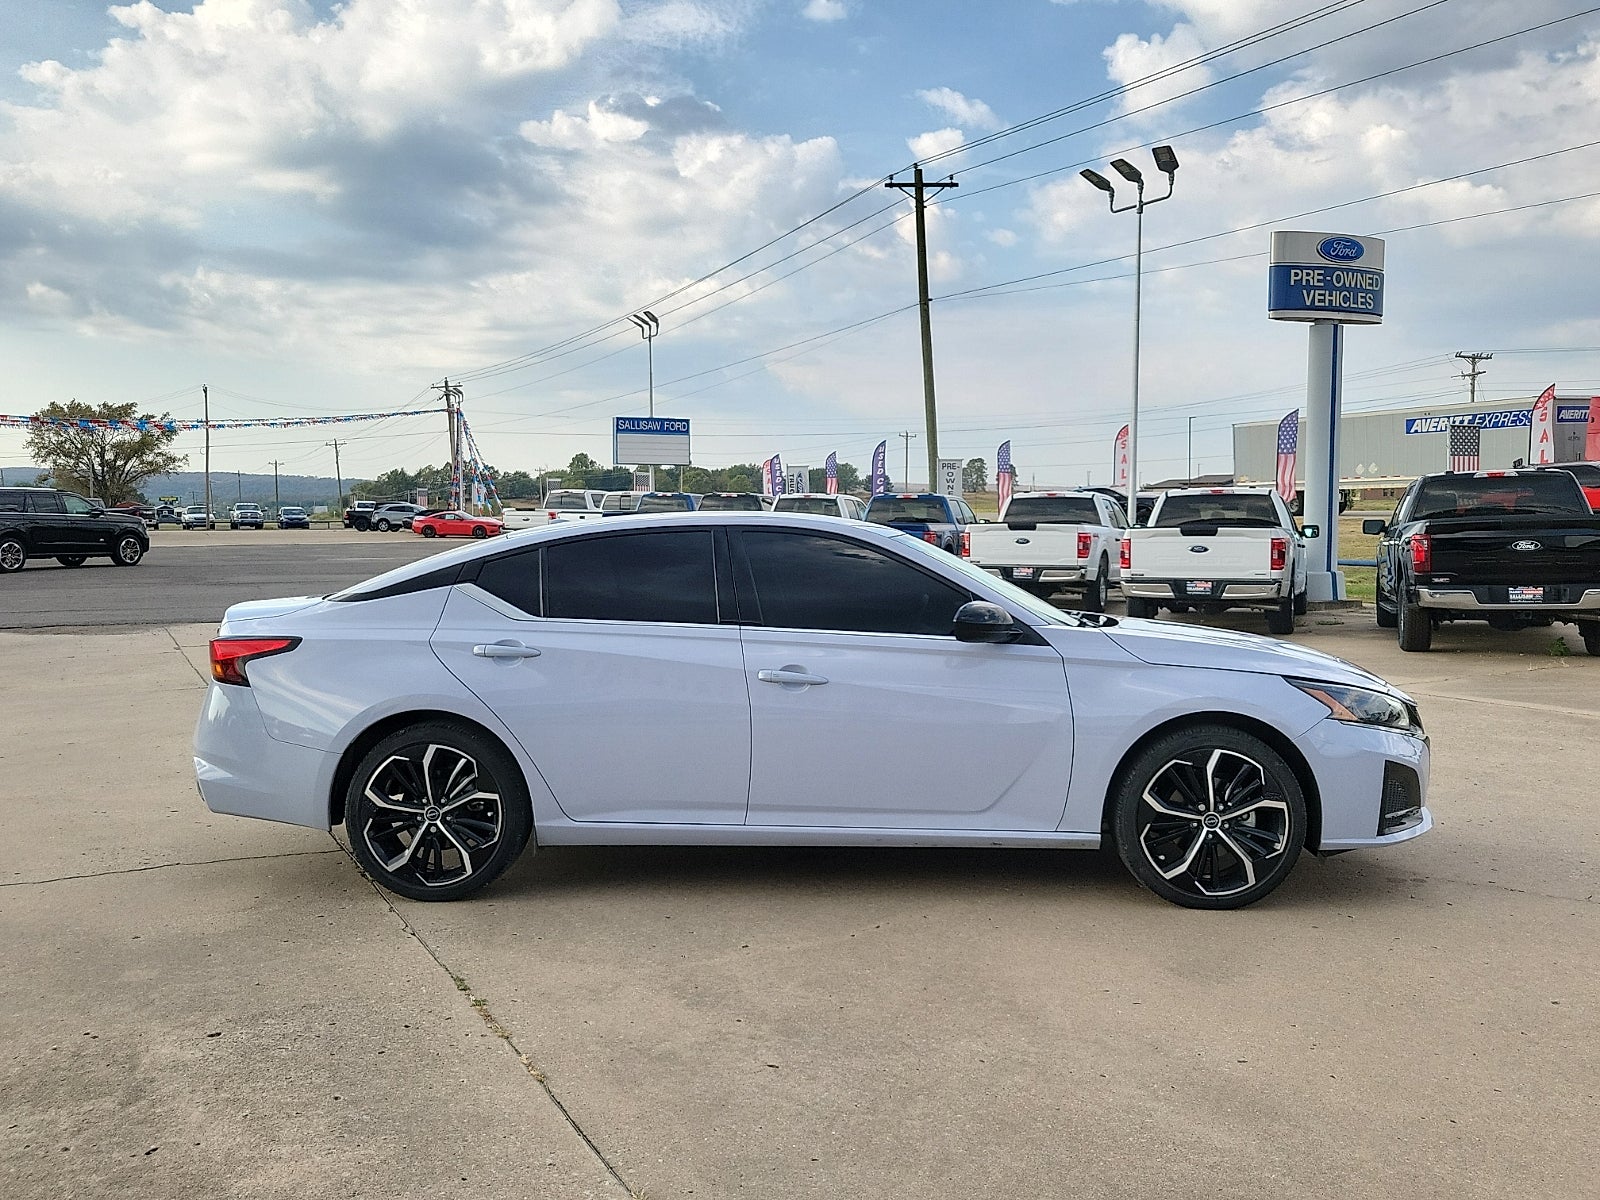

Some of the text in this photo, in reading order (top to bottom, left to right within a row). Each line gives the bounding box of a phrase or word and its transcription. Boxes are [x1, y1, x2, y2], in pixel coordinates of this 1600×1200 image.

[1330, 240, 1357, 257] Ford
[1290, 269, 1381, 291] PRE-OWNED
[1302, 289, 1374, 310] VEHICLES
[618, 420, 688, 432] SALLISAW FORD
[1410, 416, 1472, 433] AVERITT
[1539, 406, 1549, 464] SAL
[876, 445, 885, 492] USED CA
